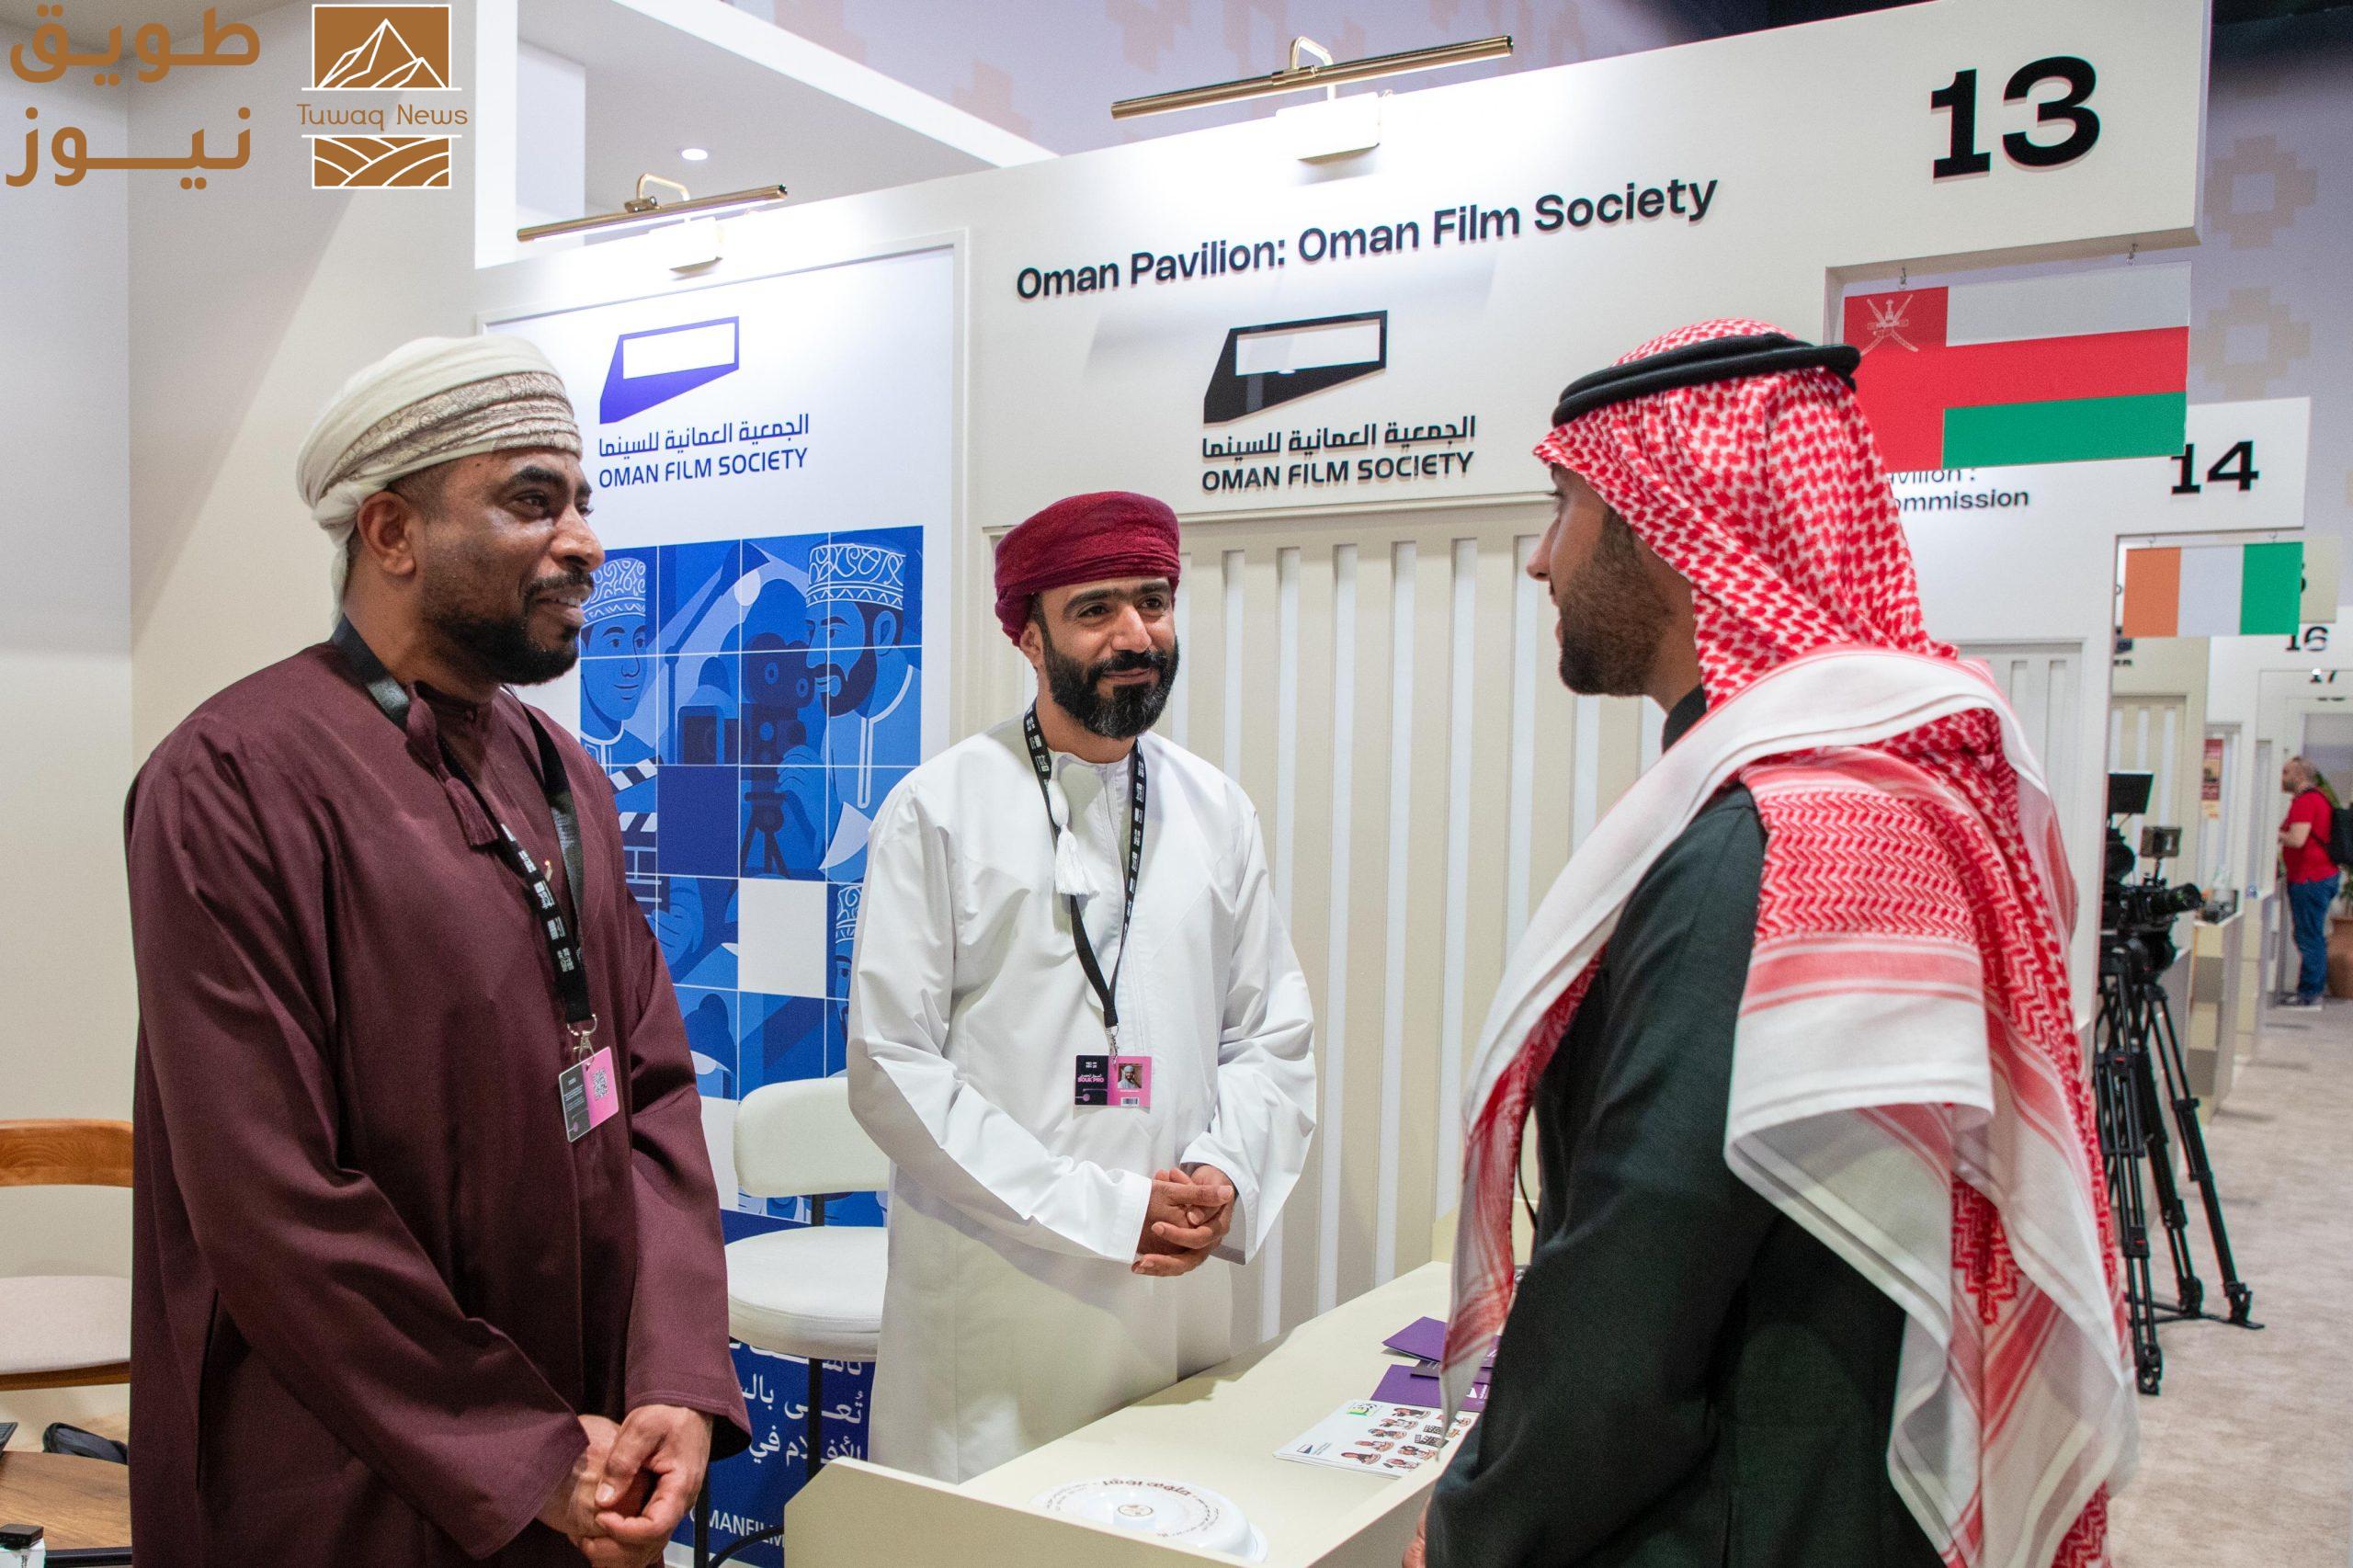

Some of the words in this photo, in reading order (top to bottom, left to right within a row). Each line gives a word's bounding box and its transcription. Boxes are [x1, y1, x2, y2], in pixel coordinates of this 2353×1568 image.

[1930, 54, 2101, 180] 13
[1017, 262, 1120, 300] Oman
[1131, 239, 1285, 285] Pavilion:
[1298, 221, 1420, 263] Oman
[1434, 204, 1520, 246] Film
[1534, 178, 1719, 232] Society
[599, 432, 659, 460] للسينما
[665, 423, 733, 454] العمانية
[738, 414, 809, 445] الجمعية
[1202, 431, 1281, 461] للسينما
[1288, 423, 1377, 456] العمانية
[1384, 415, 1476, 448] الجمعية
[598, 464, 659, 488] OMAN
[665, 458, 712, 482] FILM
[719, 448, 808, 476] SOCIETY
[1201, 465, 1280, 491] OMAN
[1288, 460, 1348, 485] FILM
[1357, 451, 1474, 481] SOCIETY
[2170, 440, 2259, 495] 14
[2285, 626, 2329, 652] 16
[748, 1425, 780, 1464] في
